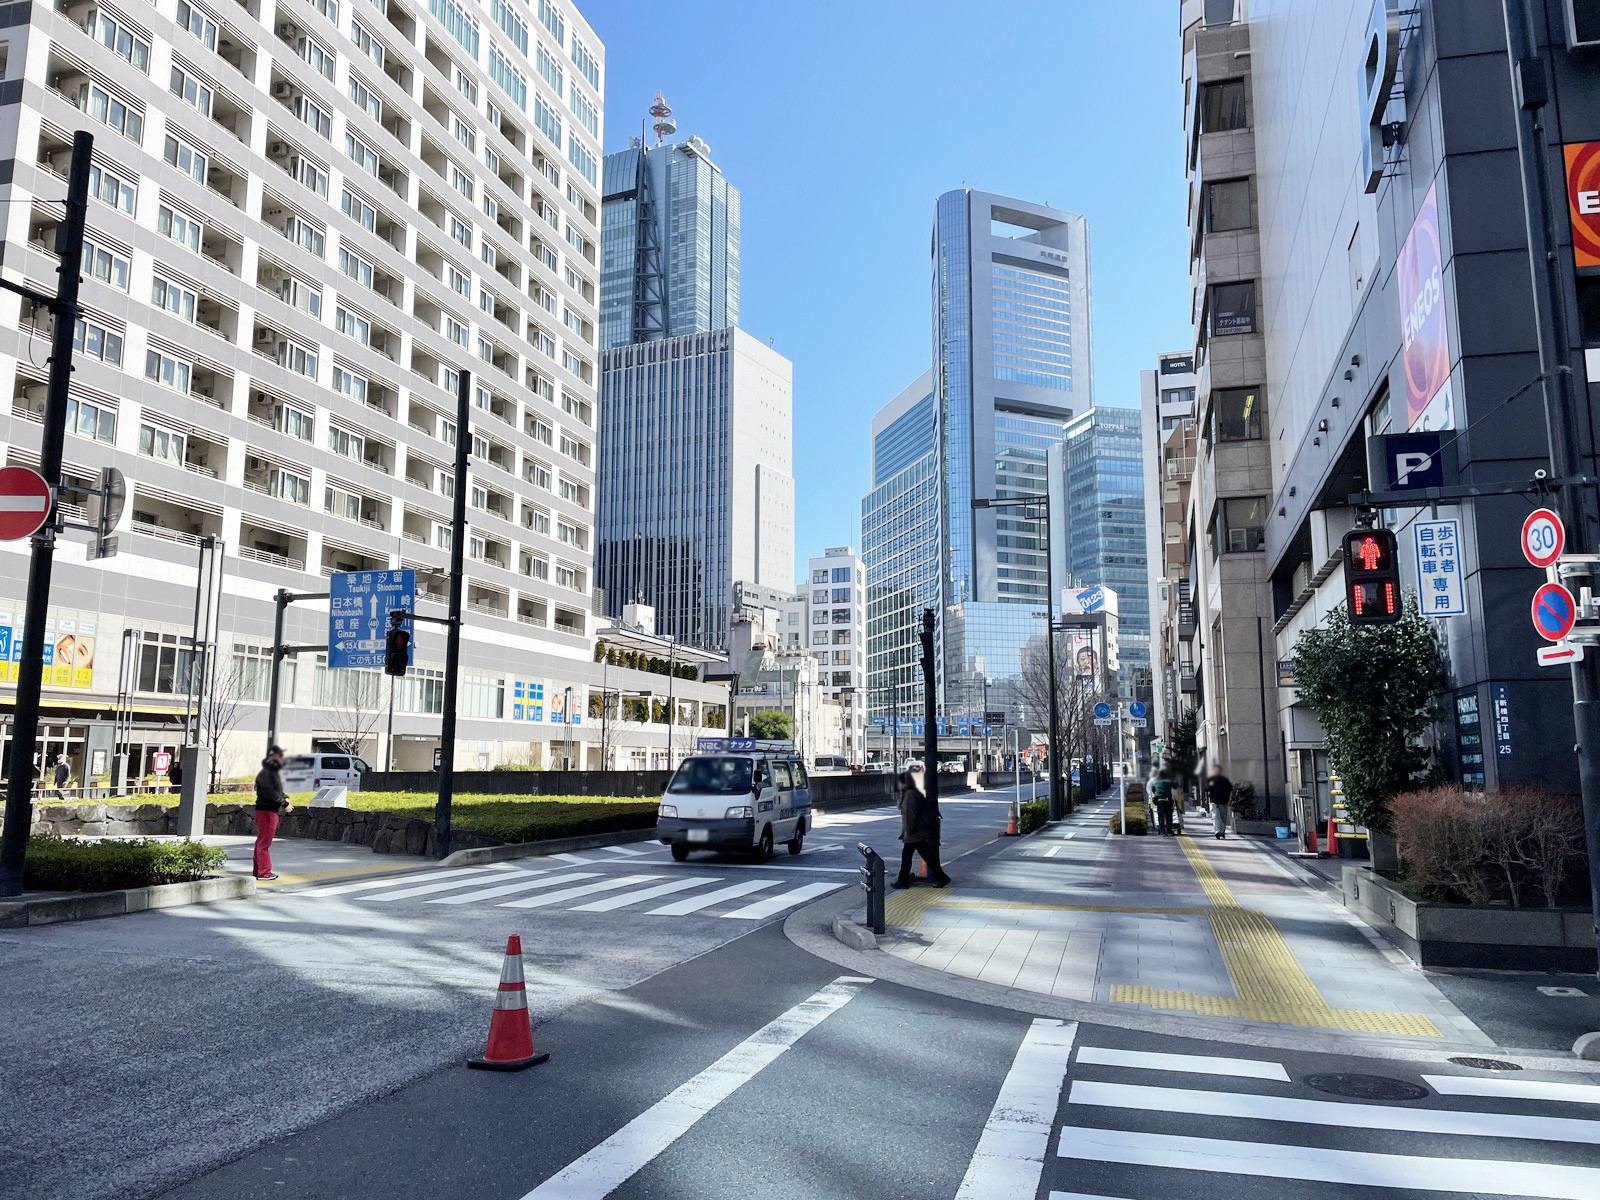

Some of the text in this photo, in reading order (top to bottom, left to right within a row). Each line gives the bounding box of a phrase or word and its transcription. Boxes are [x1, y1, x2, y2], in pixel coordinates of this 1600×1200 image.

[1404, 265, 1440, 352] ENEOS
[1396, 452, 1432, 485] P
[1531, 525, 1554, 551] 30
[1420, 527, 1437, 574] 自転車
[1437, 526, 1456, 573] 歩行者
[347, 572, 403, 585] 築地 汐留
[348, 584, 403, 593] Tsukiji Shiodome
[1433, 577, 1450, 609] 専用
[332, 597, 363, 608] 日本橋
[385, 595, 411, 606] 川崎
[1081, 590, 1104, 609] 0123
[332, 609, 364, 617] Nihonbashi
[335, 619, 359, 630] 銀座
[337, 630, 356, 638] Ginza
[730, 741, 752, 749] ナック
[1500, 745, 1511, 754] 25
